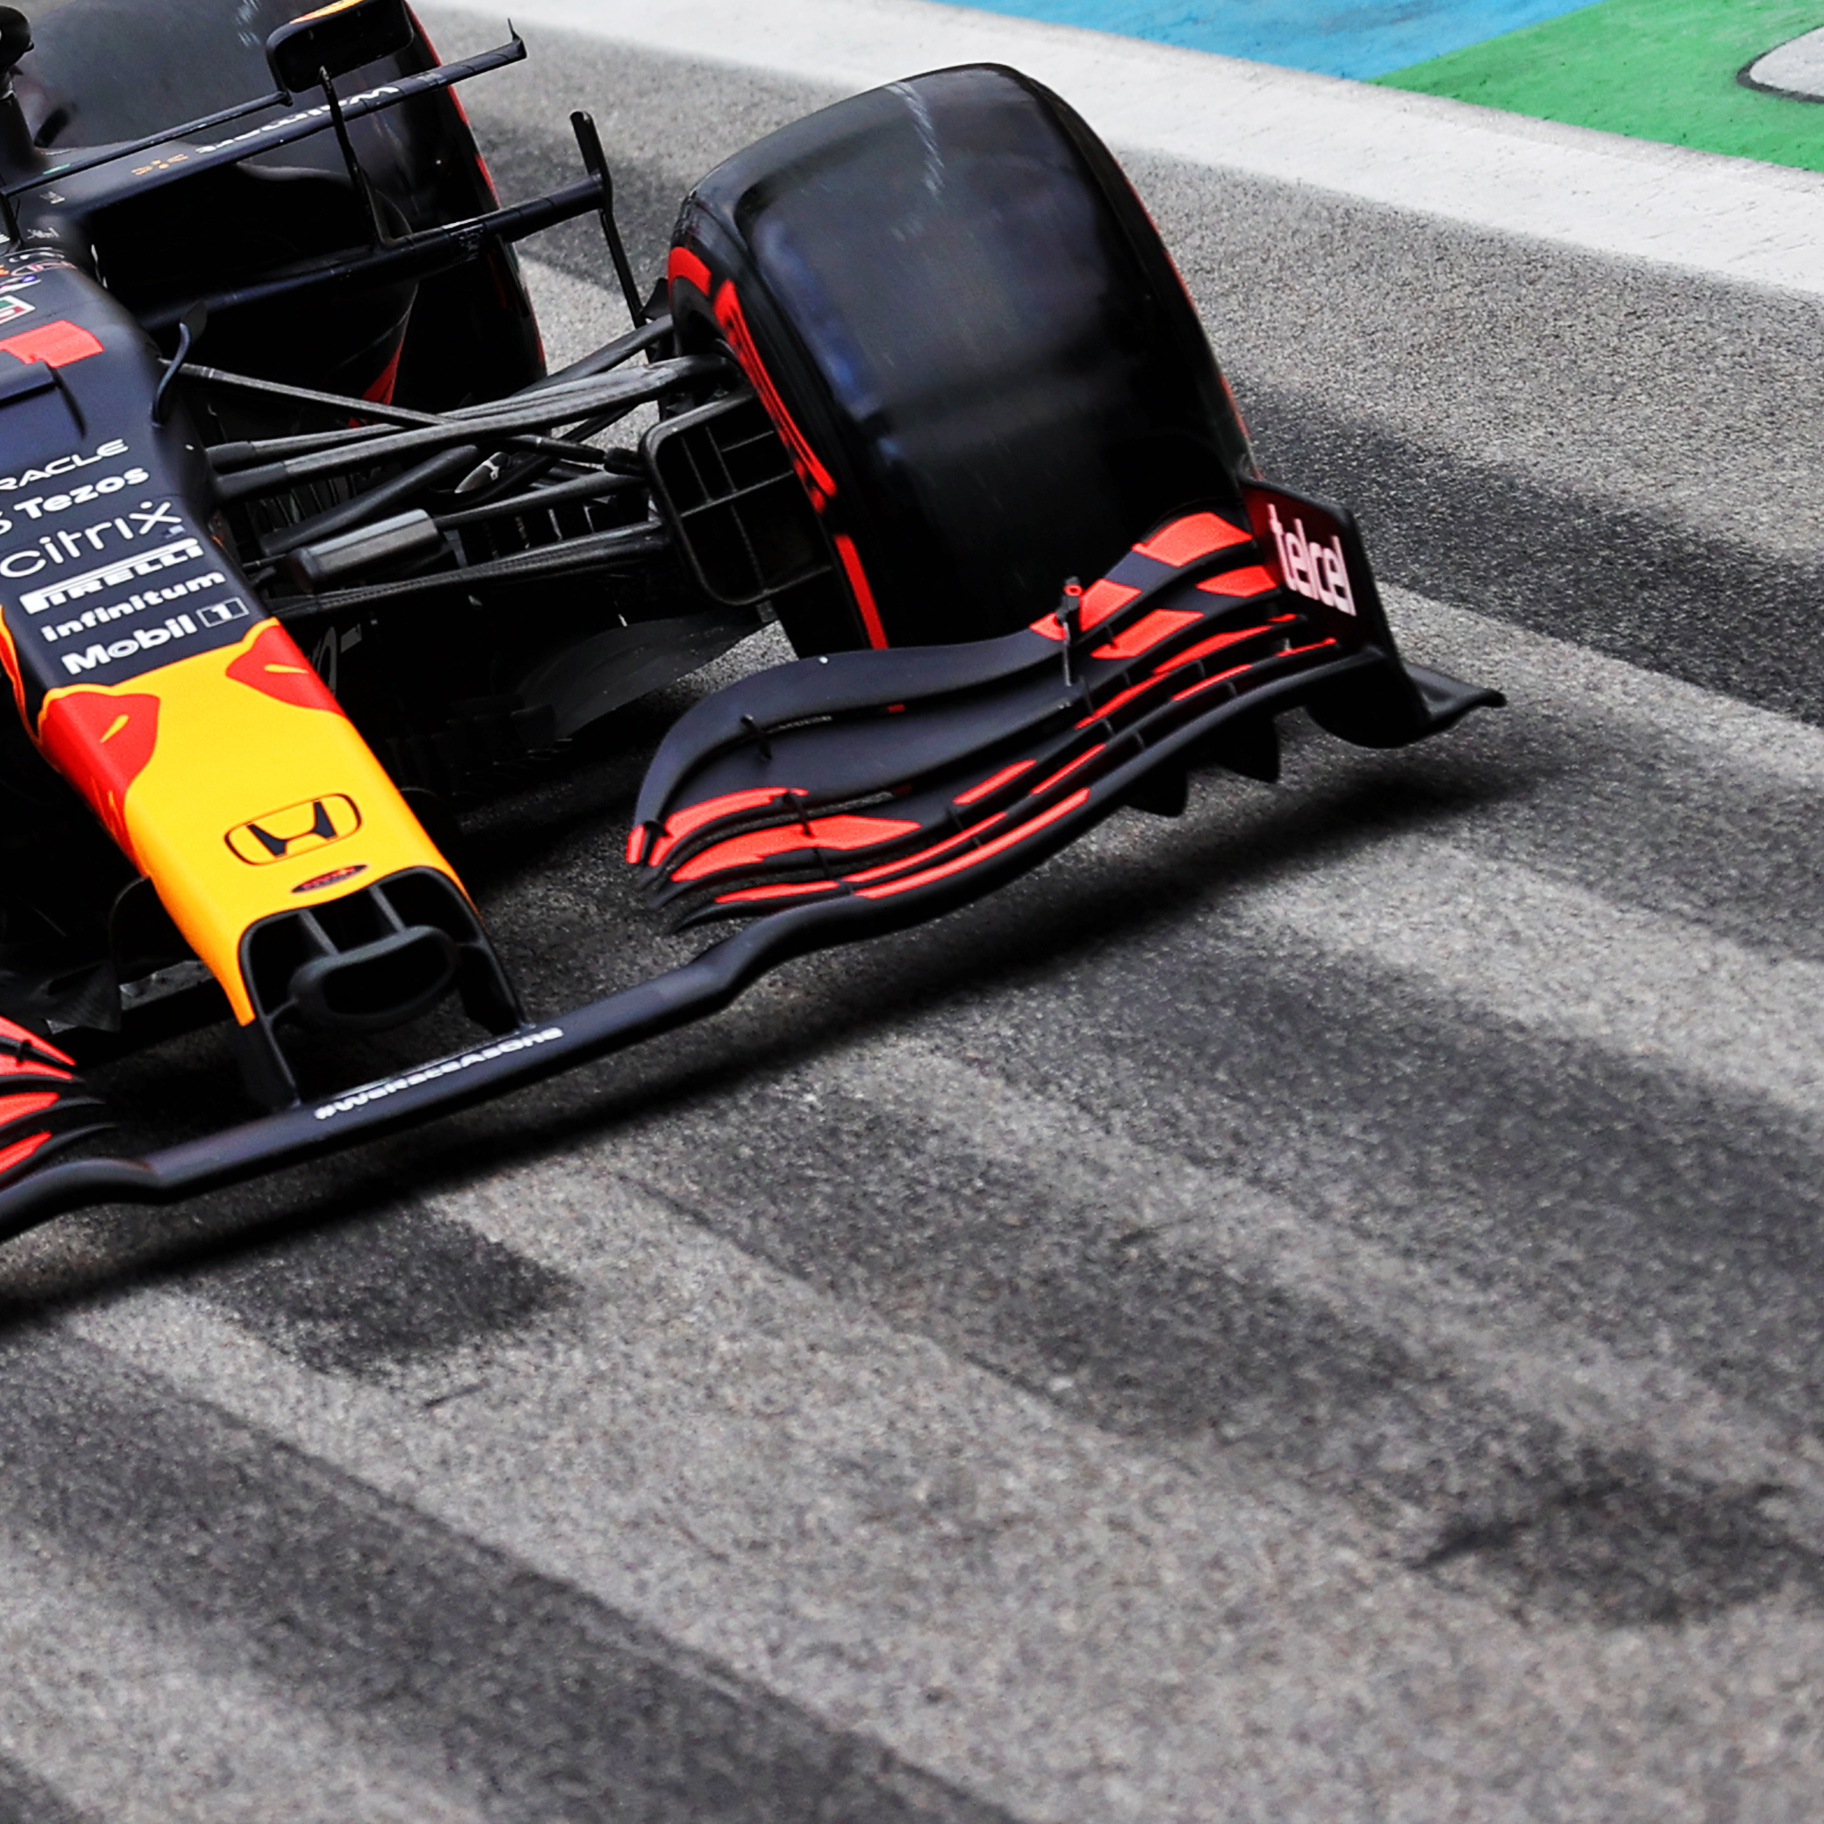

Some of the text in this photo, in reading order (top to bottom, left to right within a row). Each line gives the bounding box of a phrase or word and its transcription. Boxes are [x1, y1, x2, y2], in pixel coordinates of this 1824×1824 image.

[13, 466, 150, 520] Tezos
[19, 537, 205, 616] PIRELLI
[1266, 502, 1357, 617] telcel
[40, 570, 227, 643] infinitum
[61, 613, 199, 676] Mobil
